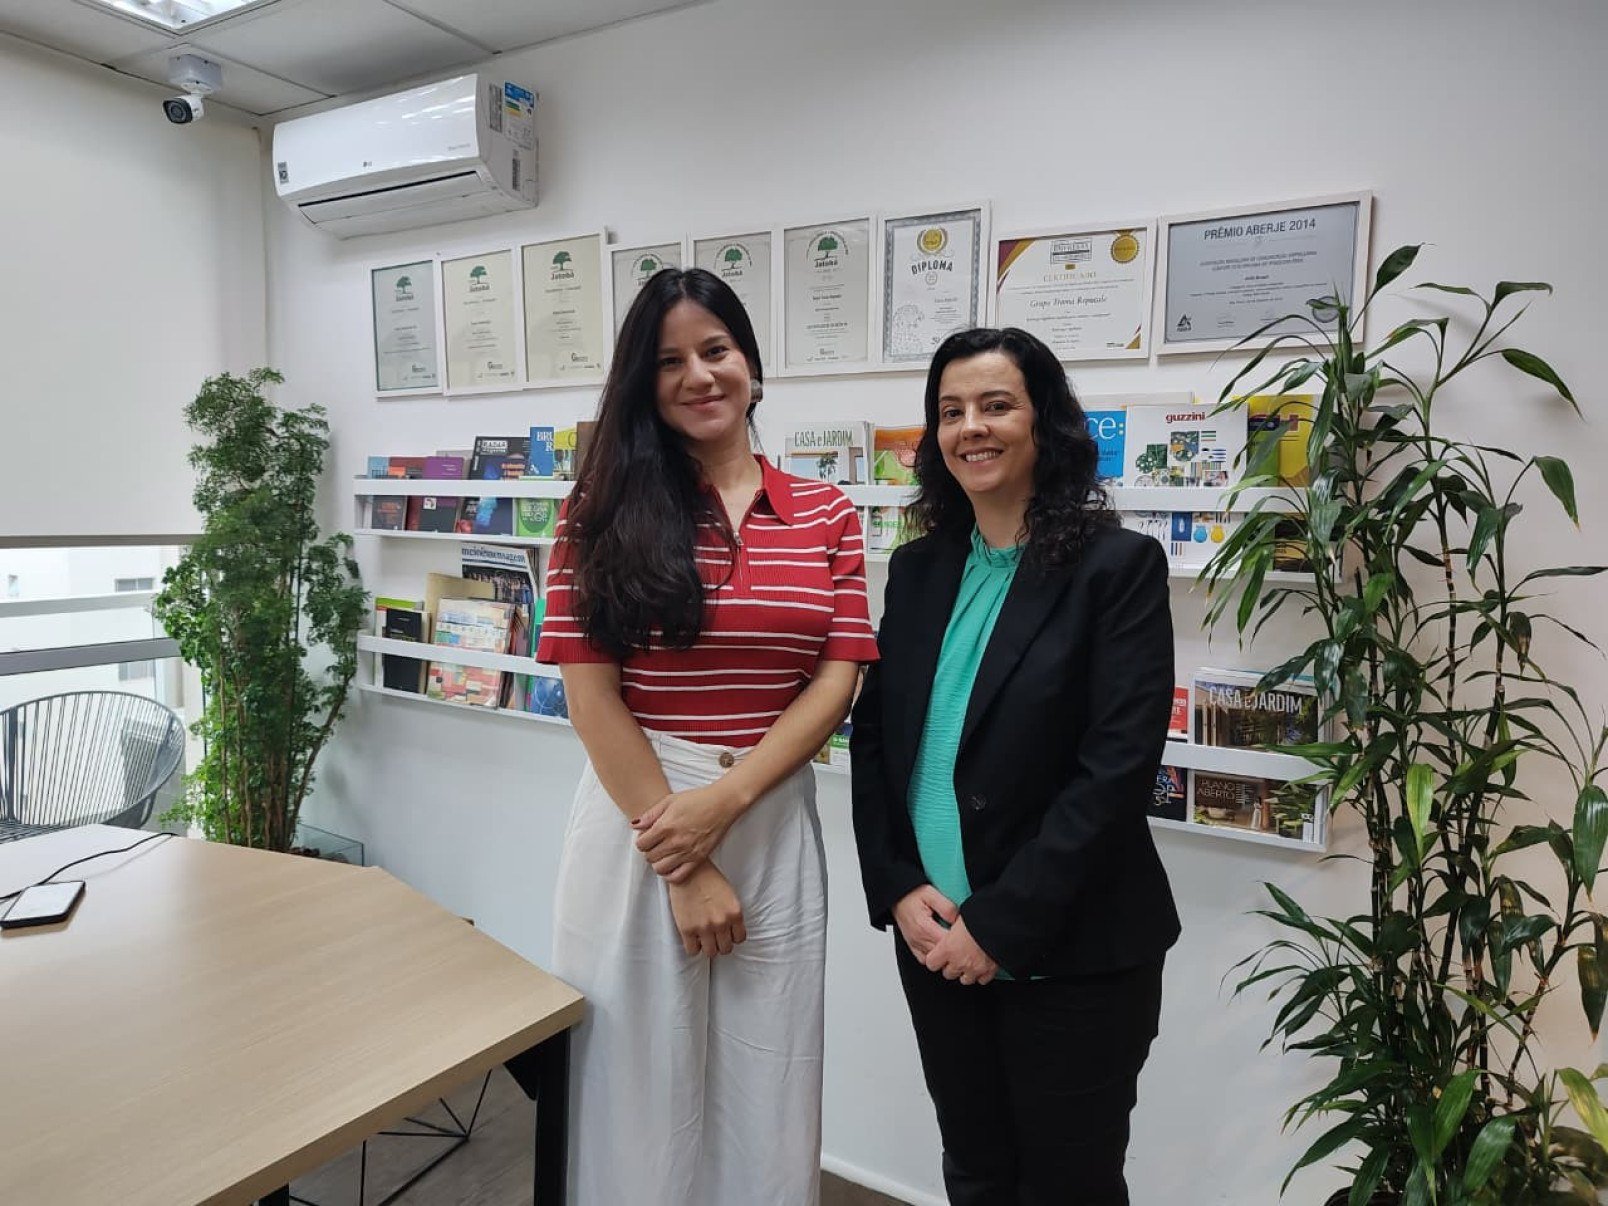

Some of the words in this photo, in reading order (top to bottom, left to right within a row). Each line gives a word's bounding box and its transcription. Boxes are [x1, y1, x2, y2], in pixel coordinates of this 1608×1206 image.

[1204, 225, 1243, 240] PRÊMIO
[1245, 221, 1286, 236] ABERJE
[1289, 218, 1316, 231] 2014
[911, 260, 953, 275] DIPLOMA
[1165, 411, 1206, 424] guzzini
[794, 431, 816, 447] CASA
[822, 430, 854, 447] JARDIM
[1209, 685, 1242, 709] CASA
[1253, 690, 1303, 715] JARDIM
